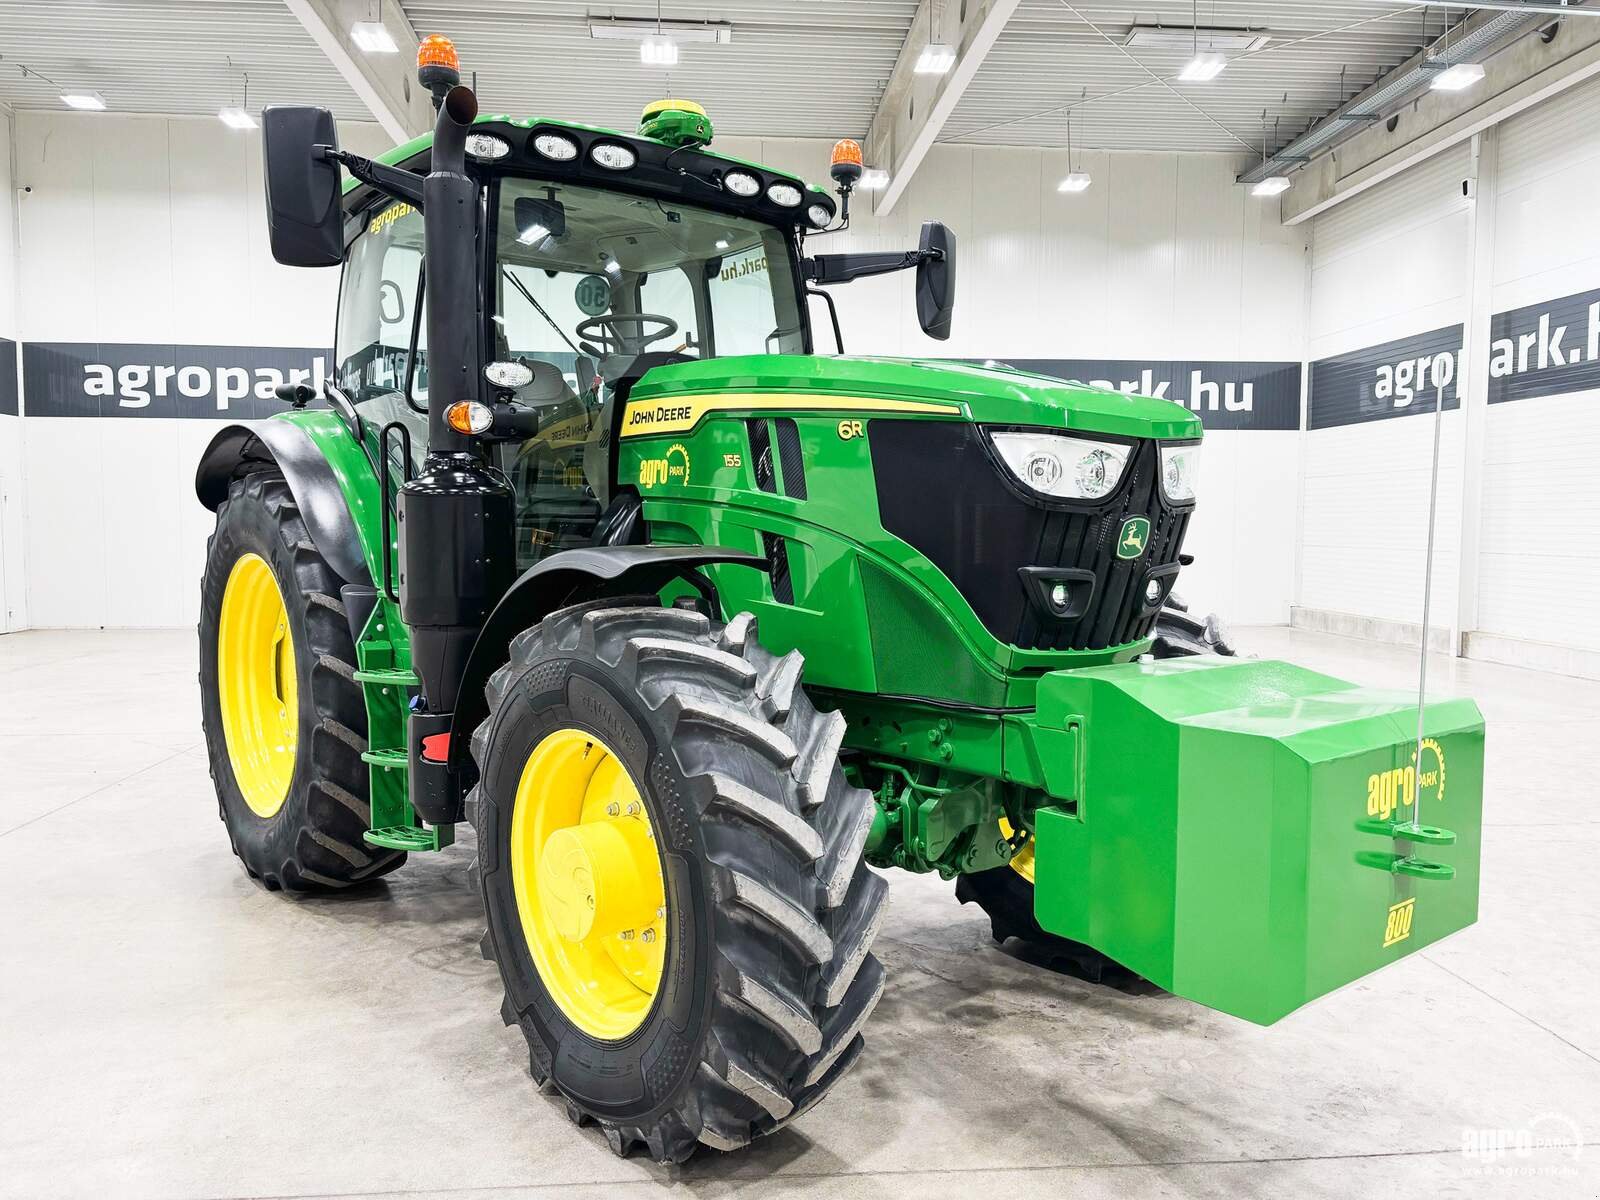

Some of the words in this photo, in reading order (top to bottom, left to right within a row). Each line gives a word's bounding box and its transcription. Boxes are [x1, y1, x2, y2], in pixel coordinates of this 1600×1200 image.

[629, 410, 654, 425] JOHN
[656, 406, 692, 421] DEERE
[836, 420, 864, 440] 6R
[723, 454, 741, 467] 155
[639, 458, 669, 489] agro
[669, 466, 685, 477] PARK
[1367, 766, 1415, 820] agro
[1385, 904, 1414, 942] 800
